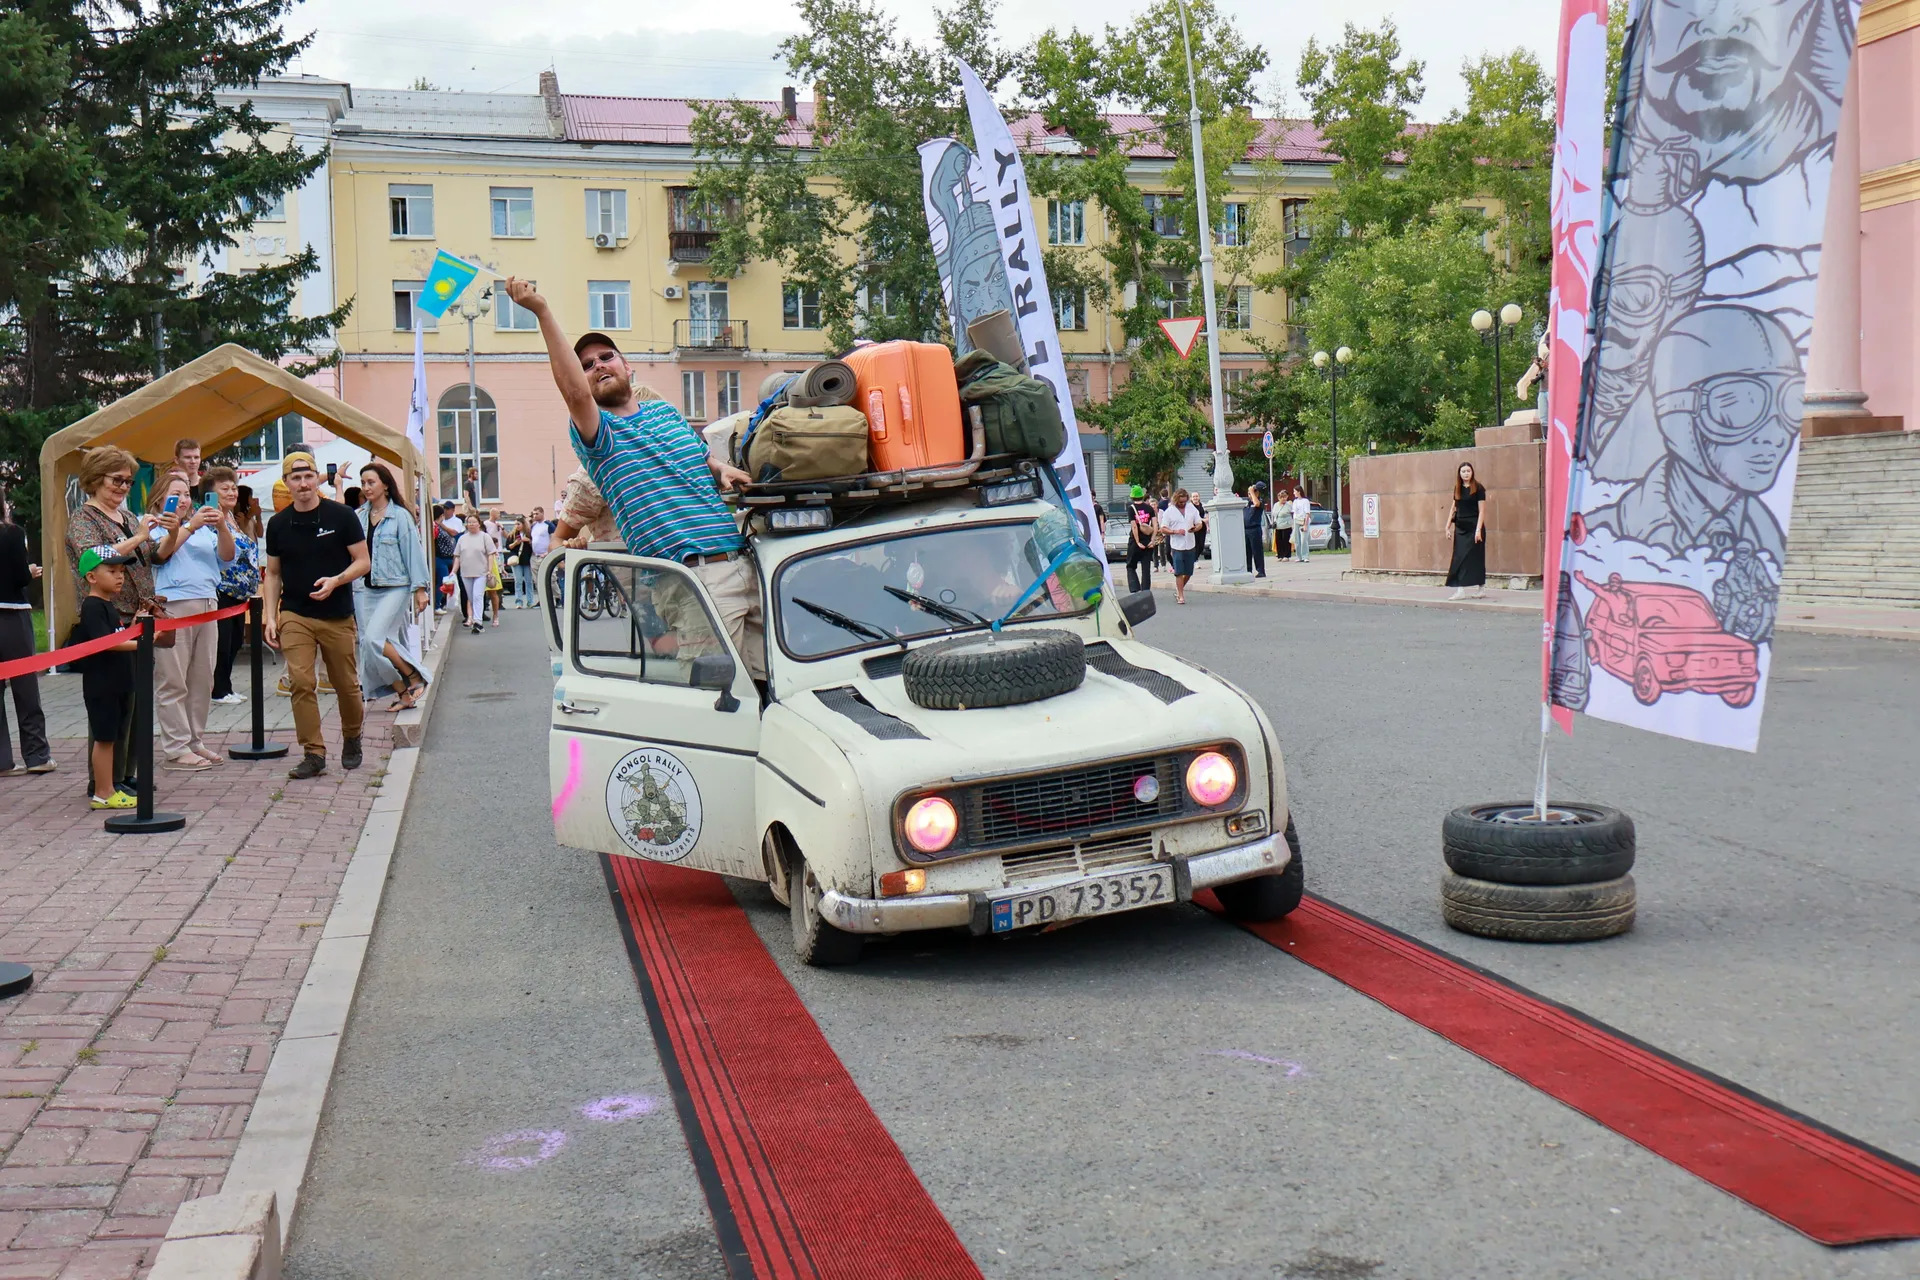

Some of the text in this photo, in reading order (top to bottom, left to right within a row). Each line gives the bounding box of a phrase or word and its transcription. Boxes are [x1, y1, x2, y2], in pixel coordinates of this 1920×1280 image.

[994, 148, 1038, 319] RALLY
[615, 754, 683, 782] MONGOL RALLY
[624, 827, 695, 857] THE ADVENTURISTS
[1018, 873, 1165, 925] PD 73352
[999, 920, 1008, 928] N
